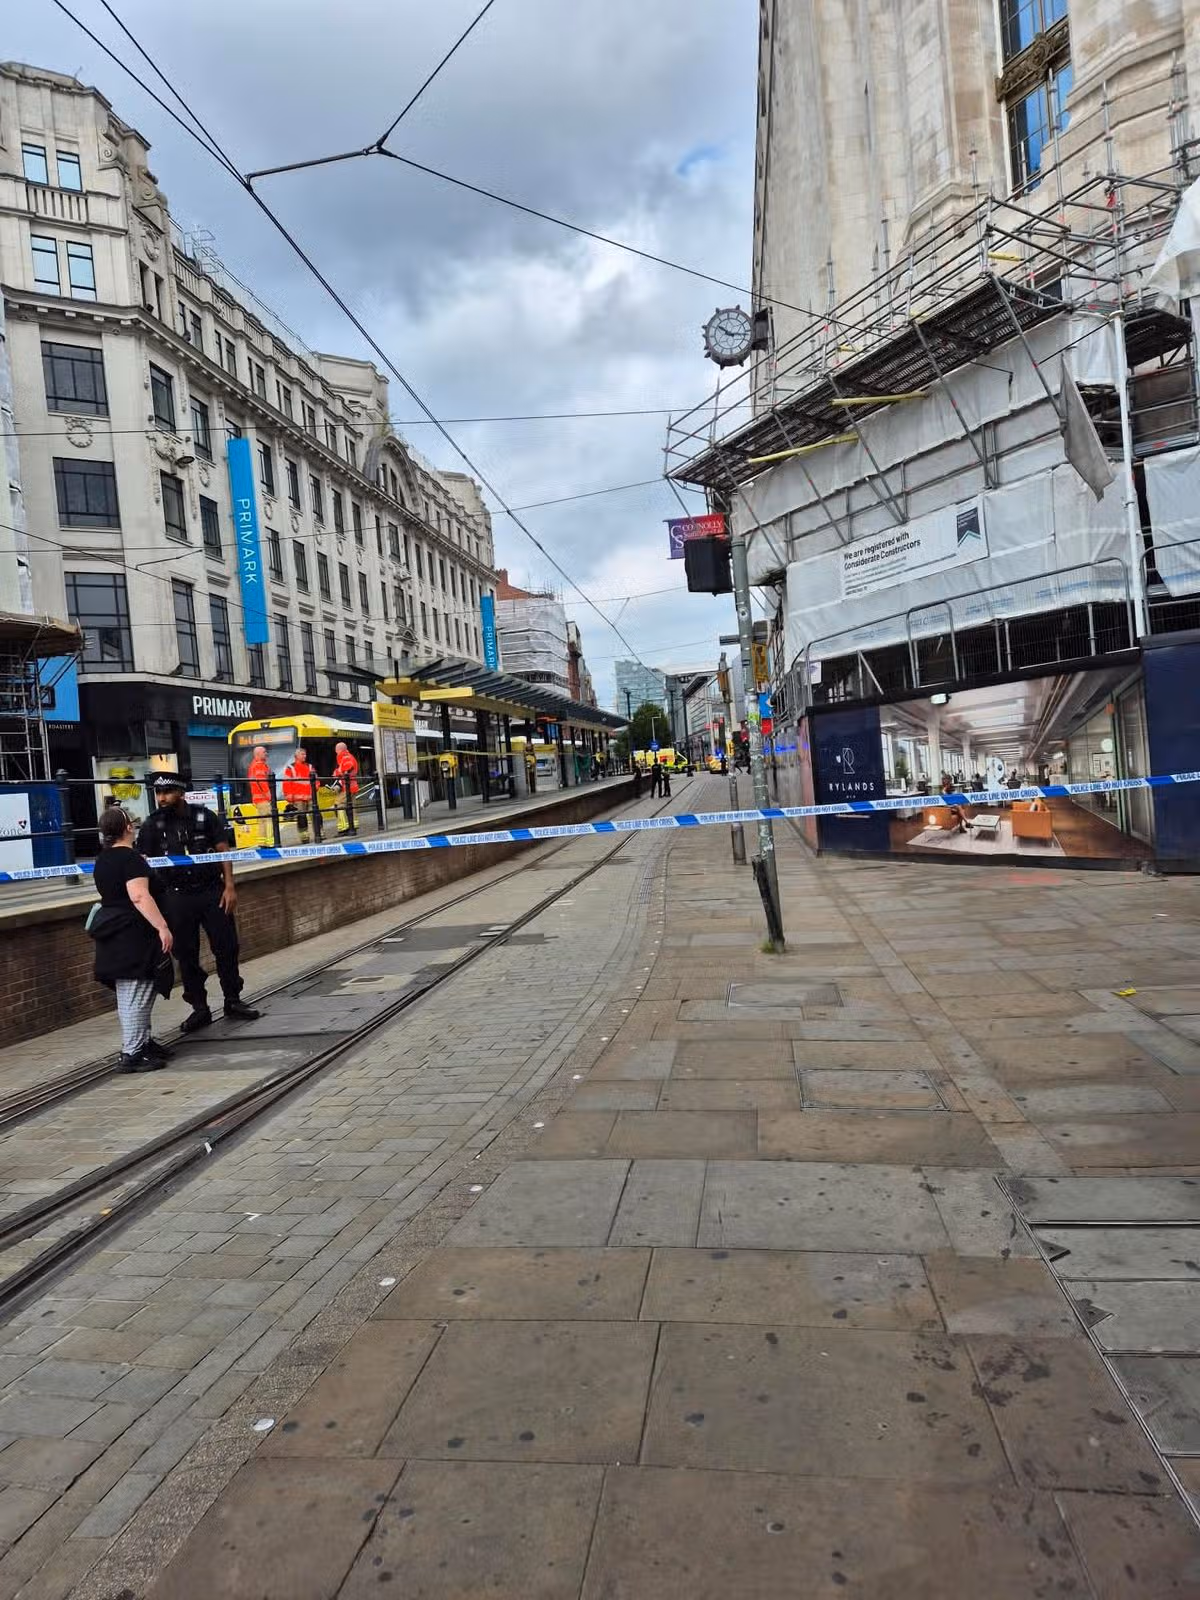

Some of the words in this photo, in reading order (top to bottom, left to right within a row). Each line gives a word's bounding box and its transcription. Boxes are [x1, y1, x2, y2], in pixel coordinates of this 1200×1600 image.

[682, 520, 723, 531] CONOLLY
[237, 498, 258, 584] PRIMARK
[844, 552, 853, 561] We
[853, 549, 864, 558] are
[864, 537, 895, 554] registered
[896, 531, 910, 543] with
[844, 554, 880, 571] Considerate
[881, 539, 921, 559] Constructors
[193, 696, 253, 718] PRIMARK
[829, 783, 874, 791] RYLANDS
[1090, 783, 1102, 791] LINE
[1103, 782, 1111, 790] DO
[970, 793, 988, 801] POLICE
[989, 792, 1000, 800] LINE
[1001, 791, 1008, 799] DO
[1009, 790, 1020, 798] NOT
[1020, 788, 1038, 797] CROSS
[876, 801, 892, 809] POLICE
[924, 797, 940, 805] CROSS
